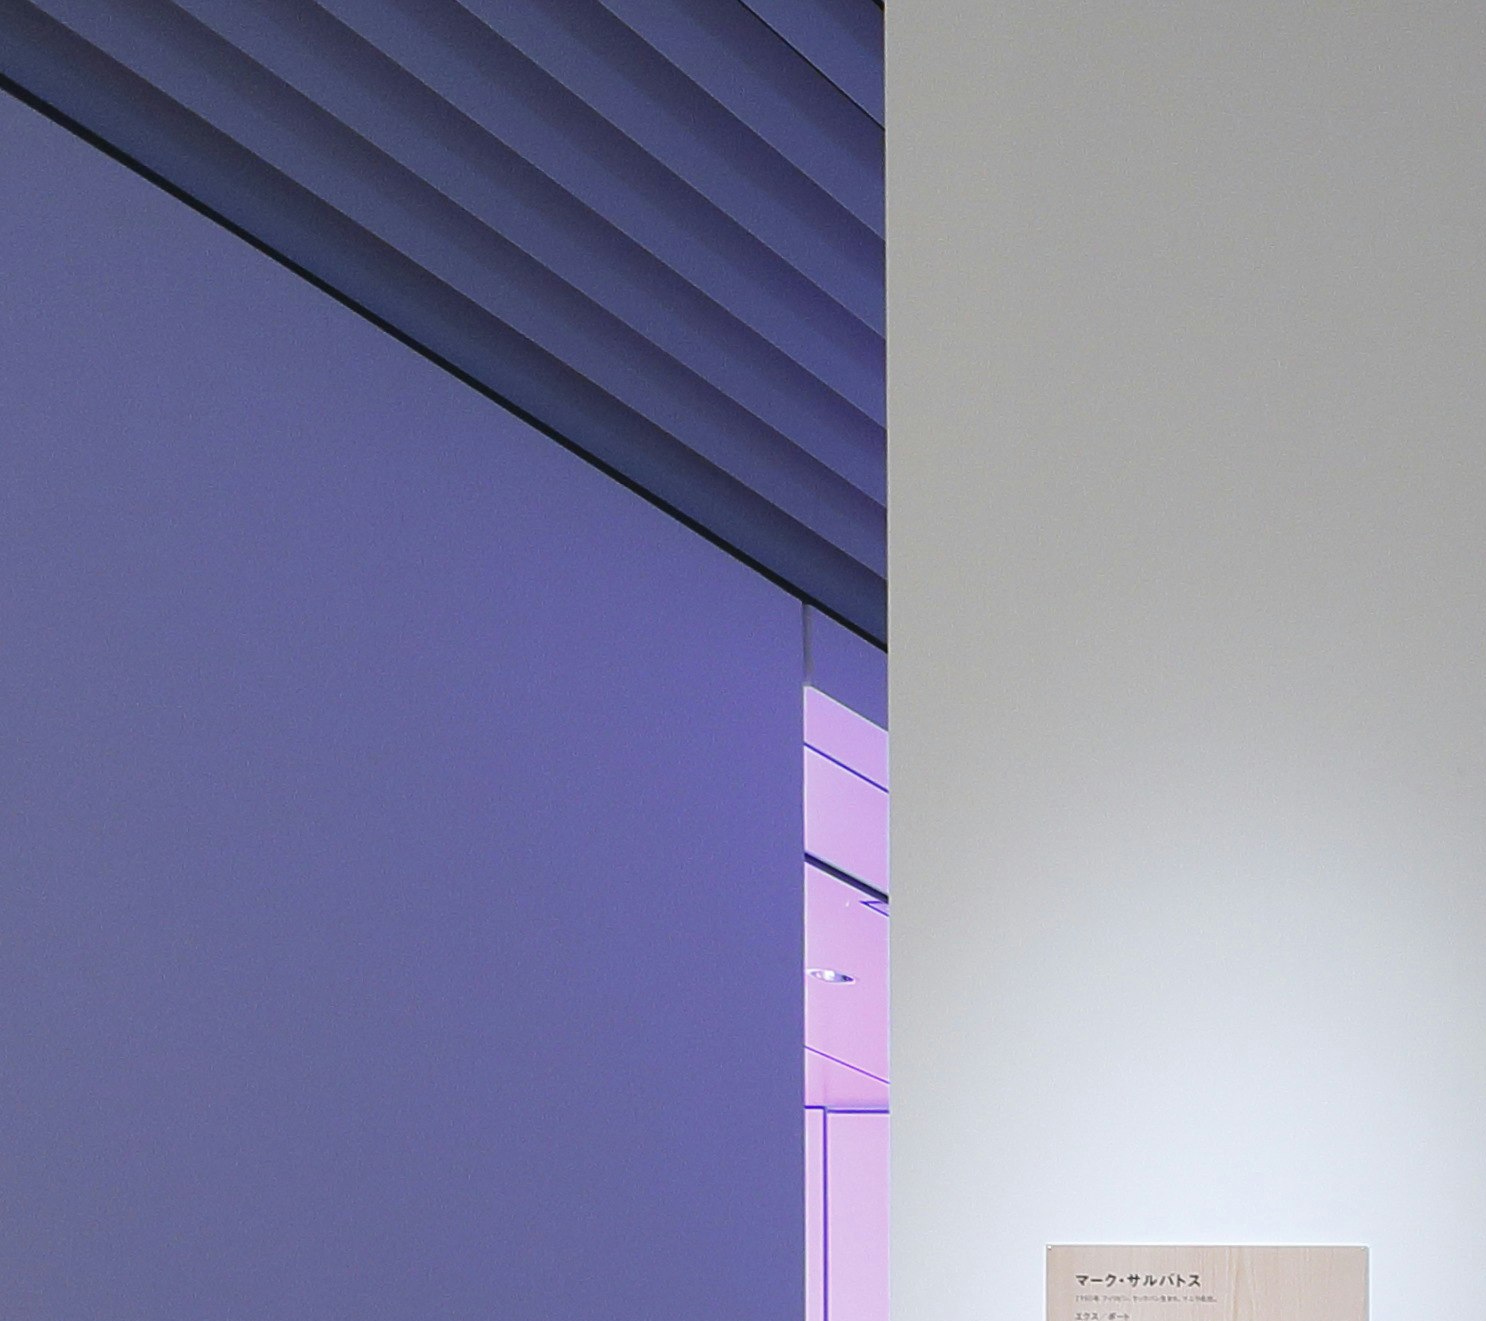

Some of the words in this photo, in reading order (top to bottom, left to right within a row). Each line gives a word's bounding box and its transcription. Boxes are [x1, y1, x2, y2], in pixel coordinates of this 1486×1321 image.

[1075, 1273, 1202, 1288] マーク・サルバトス
